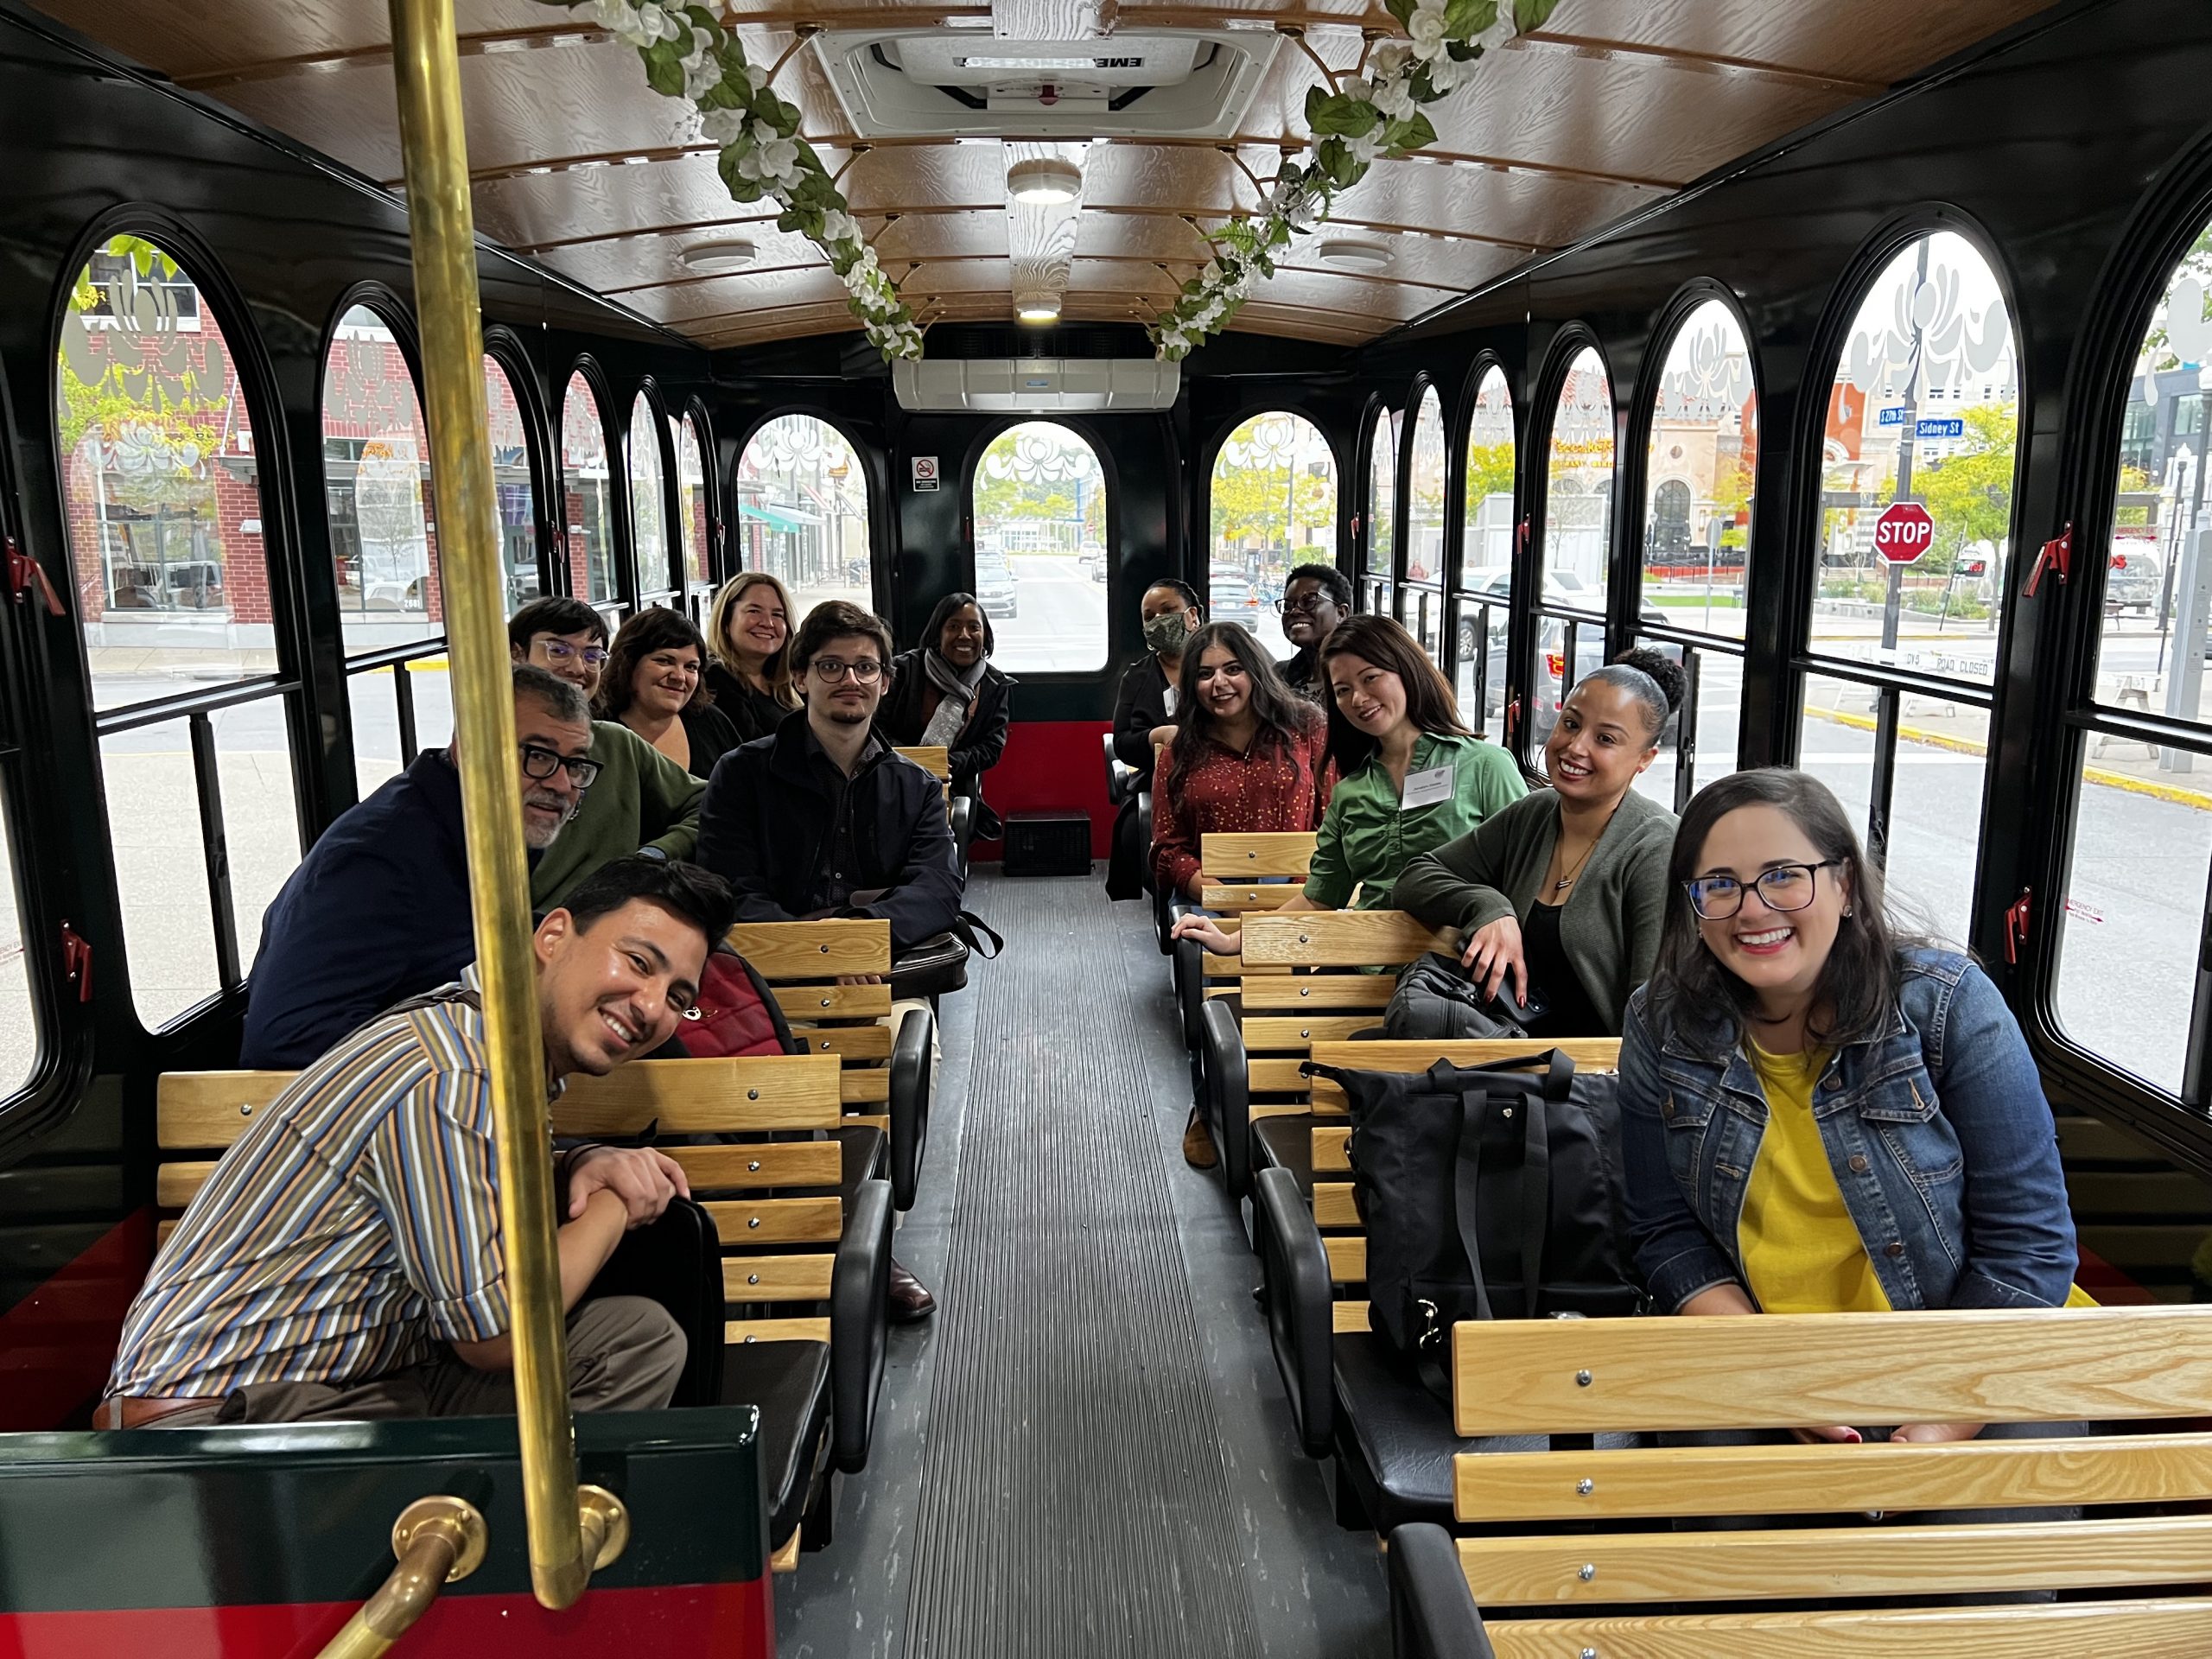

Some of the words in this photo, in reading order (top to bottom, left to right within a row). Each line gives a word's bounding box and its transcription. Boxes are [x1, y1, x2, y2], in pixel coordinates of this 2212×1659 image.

[1885, 410, 1897, 422] 27th
[1919, 422, 1948, 435] Sidney
[1949, 422, 1960, 434] St
[1878, 521, 1930, 543] STOP
[1936, 658, 1955, 671] ROAD
[1960, 660, 1988, 676] CLOSED
